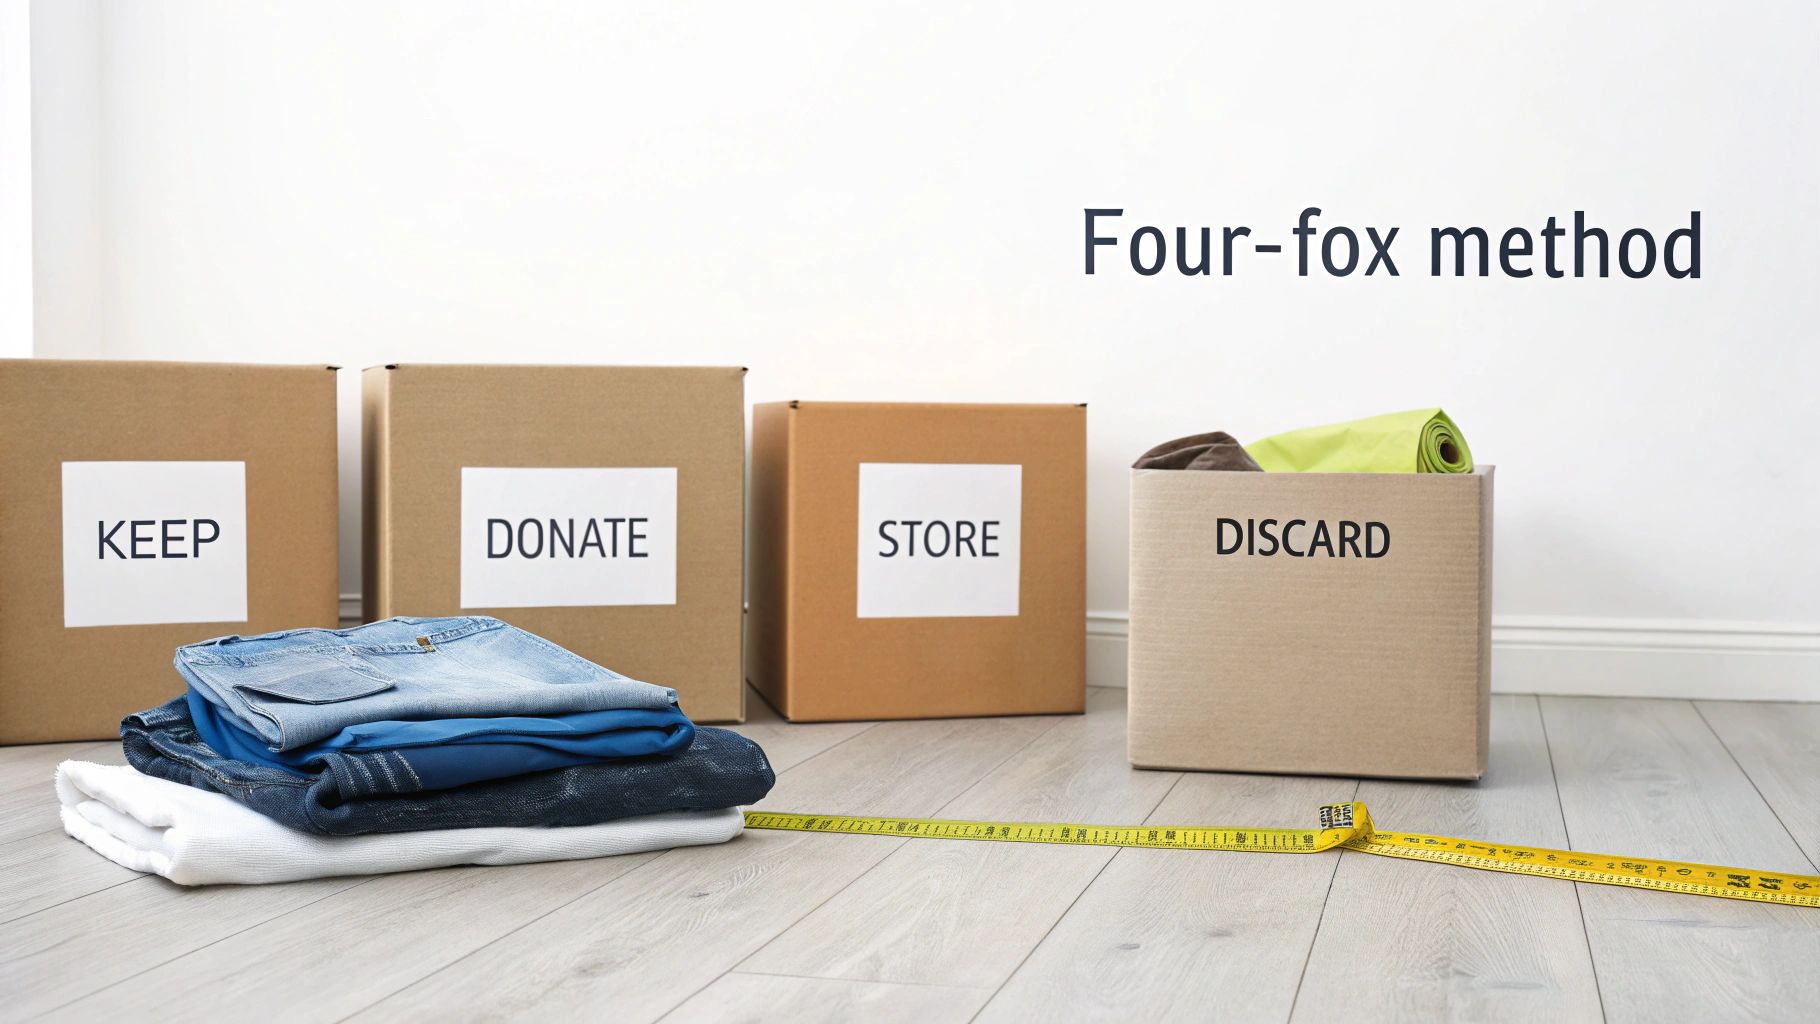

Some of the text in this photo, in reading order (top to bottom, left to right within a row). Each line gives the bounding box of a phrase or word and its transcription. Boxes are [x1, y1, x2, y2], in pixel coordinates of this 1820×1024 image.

[97, 518, 220, 561] KEEP
[487, 517, 649, 559] DONATE
[878, 520, 1000, 558] STORE
[1215, 517, 1391, 559] DISCARD
